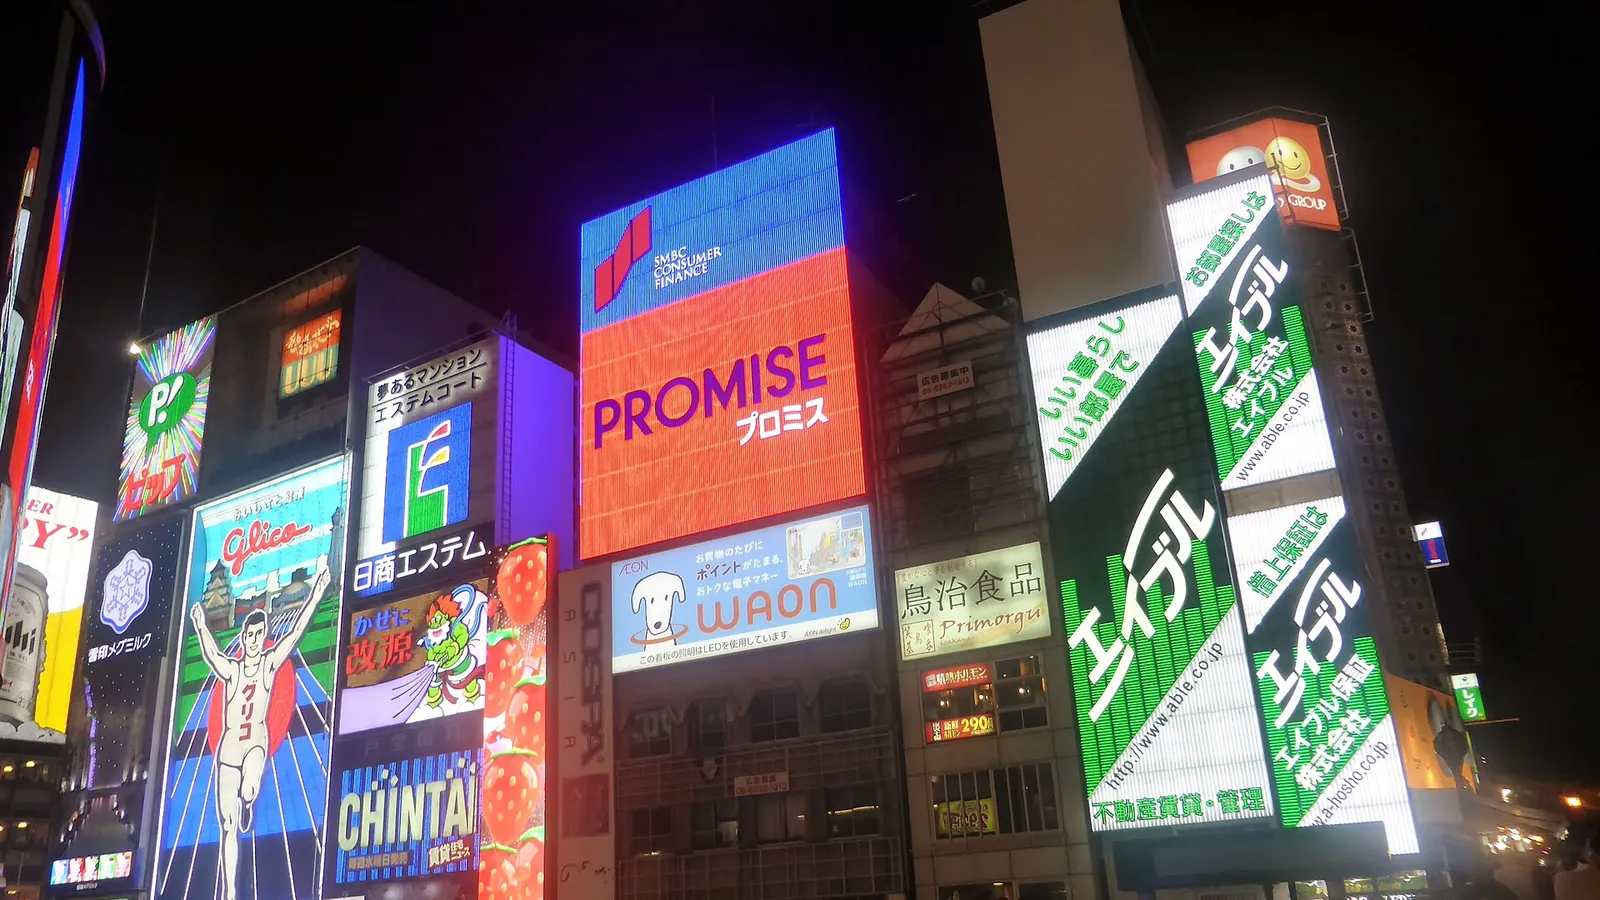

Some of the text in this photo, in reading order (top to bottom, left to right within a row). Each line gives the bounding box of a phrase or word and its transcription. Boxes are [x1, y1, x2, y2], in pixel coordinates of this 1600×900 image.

[1287, 194, 1327, 211] GROUP
[653, 246, 722, 279] CONSUMER
[654, 246, 687, 266] SMBC
[1184, 190, 1267, 288] お部屋探しは
[655, 262, 708, 290] FINANCE
[376, 347, 483, 401] 夢あるマンション
[594, 333, 827, 449] PROMISE
[1038, 315, 1127, 422] いい暮らし
[1221, 335, 1289, 411] 株式会社
[375, 371, 484, 424] エステムコート
[736, 397, 829, 446] プロミス
[1049, 352, 1141, 462] いい部屋で
[1231, 365, 1295, 440] エイブル
[1236, 391, 1311, 481] www.able.co.jp
[124, 453, 187, 511] ピップ
[222, 519, 312, 576] Glico
[354, 530, 487, 592] 日商エステム
[695, 540, 764, 565] お買物のたびに
[1246, 504, 1330, 600] 借上保証は
[696, 573, 779, 597] おトクな電子マネー
[901, 562, 1042, 619] 鳥治食品
[88, 632, 152, 664] 雪印メグミルク
[354, 606, 411, 637] かぜに
[639, 630, 793, 665] この看板の照明はLEDを使用しています。
[346, 625, 415, 676] 改源
[239, 680, 259, 742] グリコ
[1104, 640, 1224, 791] http://www.able.co.jp
[1275, 653, 1376, 772] エイブル保証
[1462, 689, 1478, 718] レイク
[1294, 709, 1372, 793] 株式会社
[338, 758, 477, 851] CHINTAI
[1092, 785, 1266, 825] 不動産賃貸・管理
[428, 844, 450, 868] 賃貸
[450, 847, 471, 860] ニュース
